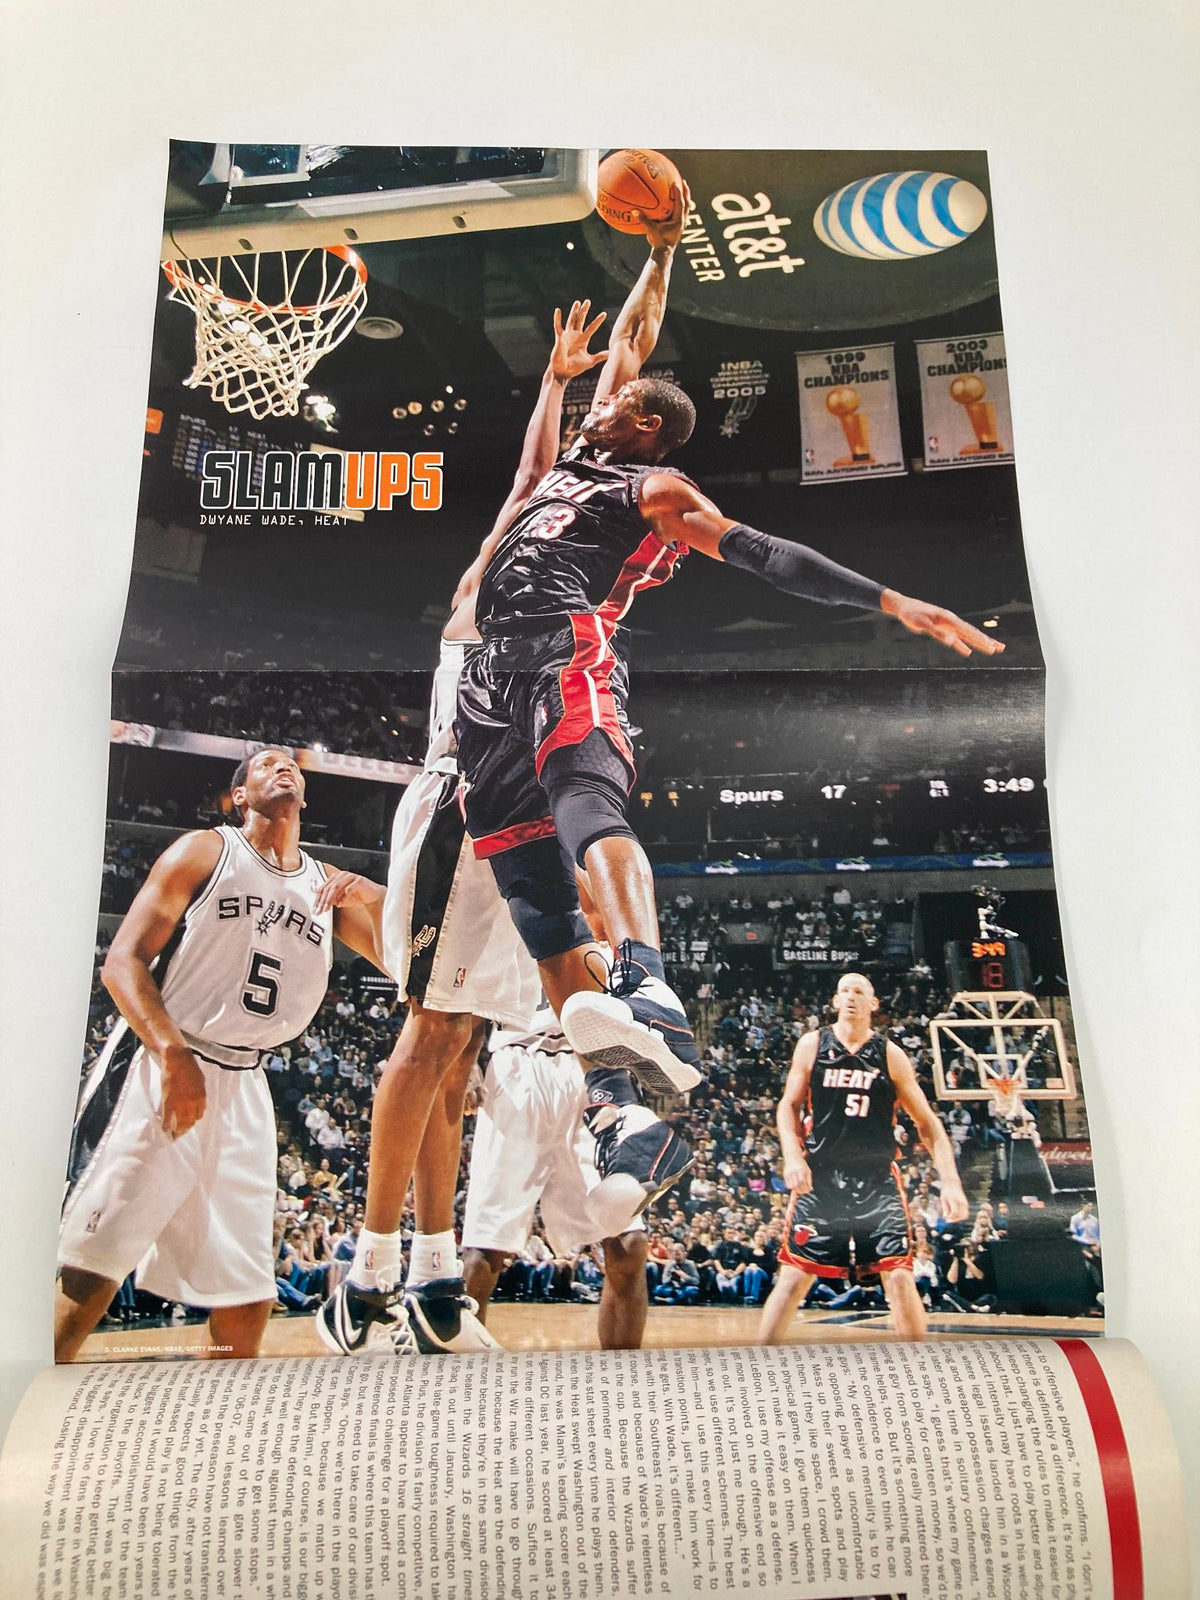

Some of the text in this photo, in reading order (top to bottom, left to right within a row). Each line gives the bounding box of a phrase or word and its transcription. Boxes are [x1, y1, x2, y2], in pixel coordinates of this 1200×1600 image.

[711, 192, 805, 278] at&t
[825, 351, 866, 365] 1999
[946, 340, 988, 353] 2003
[954, 351, 983, 363] NBA
[804, 370, 889, 389] CHAMPIONS
[831, 363, 860, 375] NBA
[714, 386, 766, 399] 2005
[200, 514, 349, 526] DWYANE WADE, HEAT
[719, 789, 785, 806] Spurs
[820, 784, 847, 801] 17
[983, 777, 1036, 794] 3:49
[217, 894, 326, 948] SPURS
[240, 946, 284, 1020] 5
[822, 1068, 881, 1091] HEAT
[844, 1093, 871, 1118] 51
[207, 1344, 234, 1353] IMAGES
[1037, 1353, 1049, 1365] to
[268, 1383, 280, 1395] do
[271, 1374, 282, 1384] to
[555, 1383, 566, 1398] he
[600, 1374, 611, 1385] of
[749, 1362, 764, 1397] LeBron,
[1042, 1363, 1065, 1414] offensive
[261, 1395, 277, 1419] that,
[556, 1399, 565, 1421] was
[599, 1387, 614, 1441] perimeter
[757, 1403, 768, 1428] use
[259, 1419, 270, 1436] we
[760, 1429, 771, 1448] my
[256, 1438, 270, 1469] have
[557, 1422, 569, 1471] Miami's
[460, 1371, 476, 1562] beaten the Wizards 16 straight
[604, 1447, 616, 1472] and
[851, 1351, 897, 1579] him the confidence to even think he can
[1005, 1353, 1060, 1583] keep changing the rules to make it easier
[254, 1468, 266, 1483] to
[377, 1375, 400, 1587] poised to challenge for a playoff spot.
[674, 1356, 704, 1592] transition points, just make him work for
[705, 1366, 736, 1590] so we use different schemes. The best
[763, 1447, 776, 1498] offense
[810, 1363, 850, 1583] Mess up their sweet spots and play
[949, 1363, 997, 1599] and weapon possession charges earned
[1071, 1471, 1082, 1488] he
[85, 1384, 132, 1597] the organization to keep getting better
[150, 1385, 191, 1598] half-assed play is not being tolerated
[250, 1484, 263, 1506] get
[280, 1389, 309, 1599] They are the defending champs and
[557, 1474, 569, 1522] leading
[606, 1477, 618, 1523] interior
[768, 1500, 778, 1517] as
[1074, 1490, 1089, 1547] confirms.
[250, 1507, 261, 1544] some
[770, 1520, 779, 1529] a
[559, 1525, 570, 1566] scorer
[771, 1531, 784, 1586] defense.
[561, 1569, 573, 1600] each
